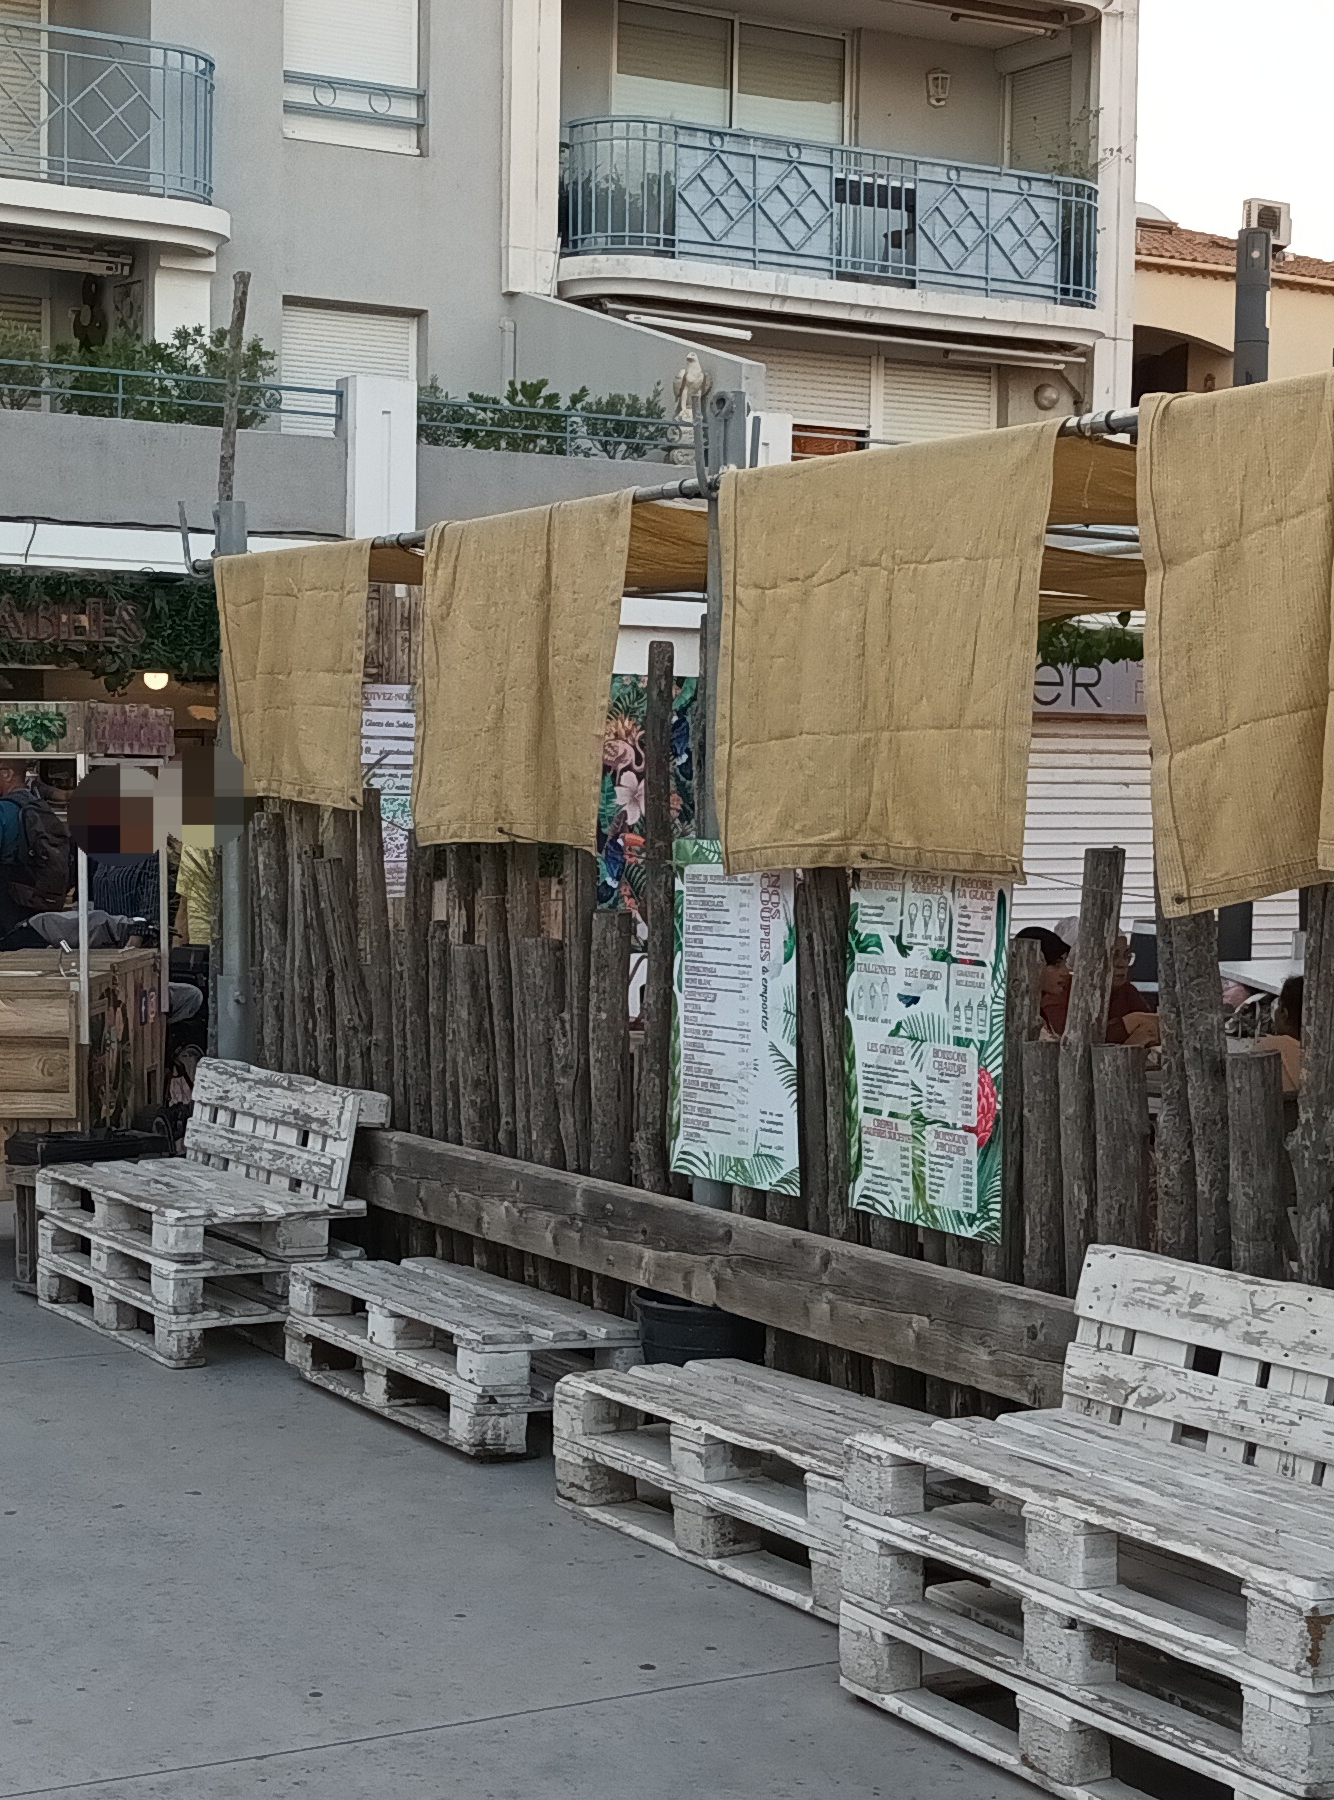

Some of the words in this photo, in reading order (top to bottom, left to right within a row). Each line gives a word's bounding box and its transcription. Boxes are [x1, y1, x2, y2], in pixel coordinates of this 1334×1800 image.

[759, 872, 771, 962] COUPES
[770, 872, 781, 921] NOS
[759, 977, 770, 1034] emporter
